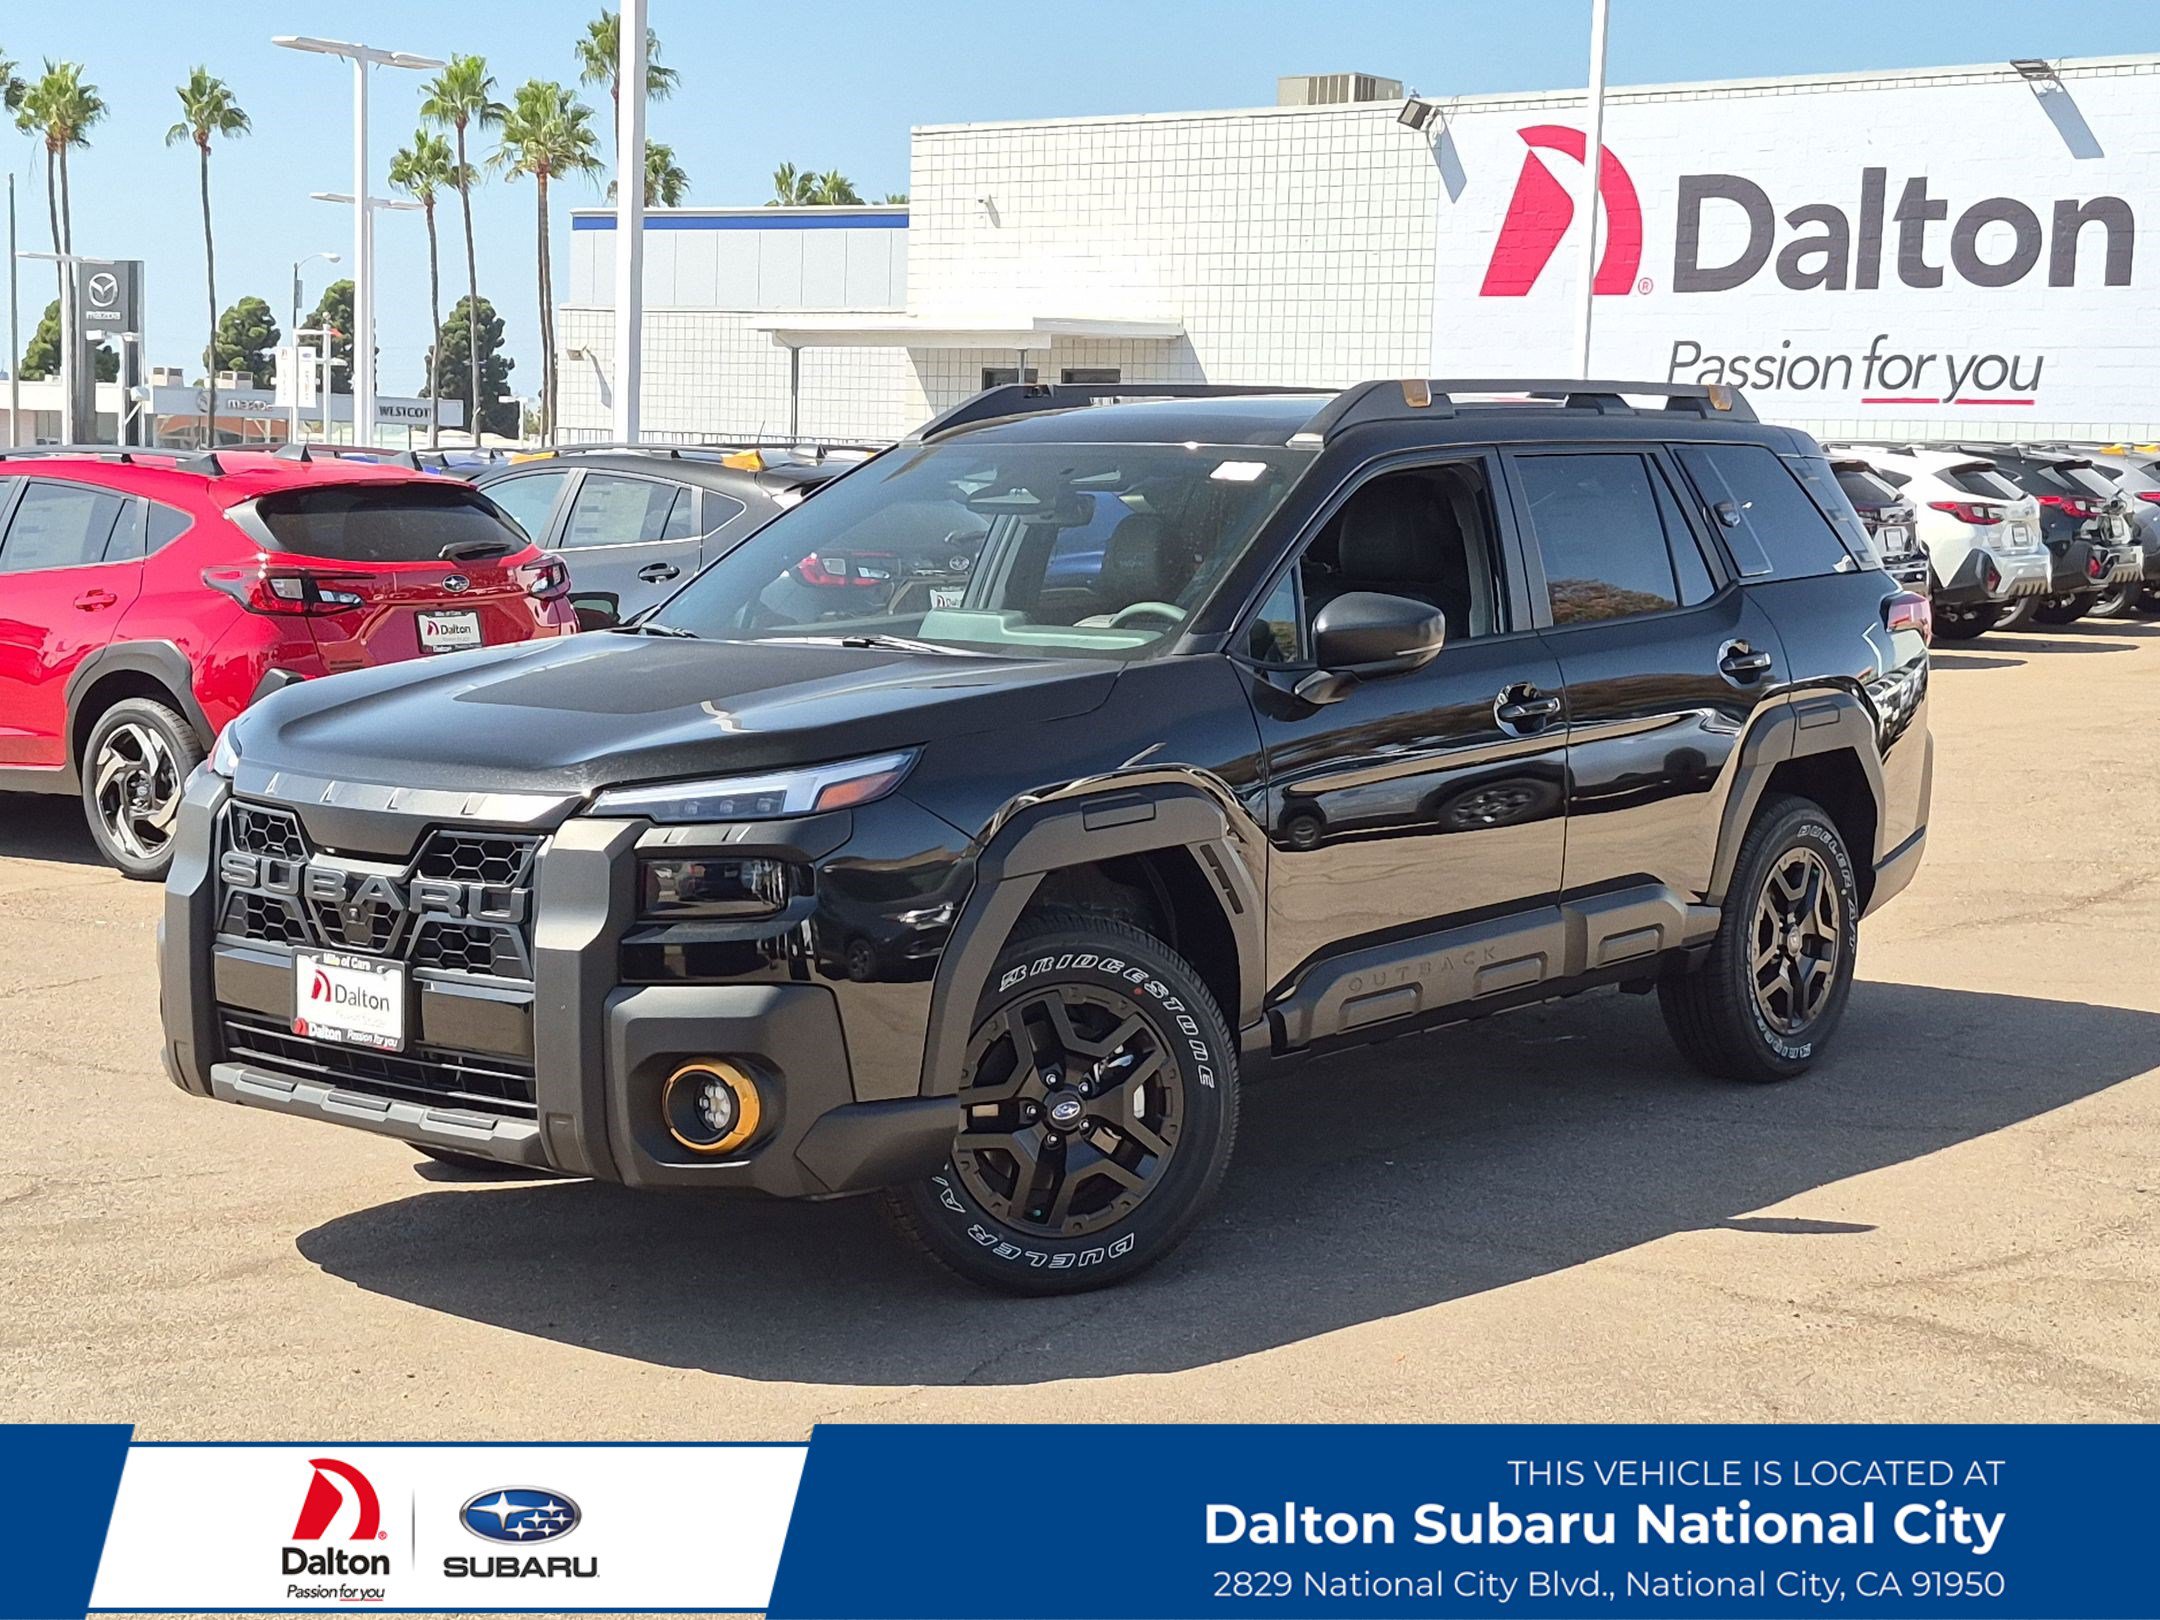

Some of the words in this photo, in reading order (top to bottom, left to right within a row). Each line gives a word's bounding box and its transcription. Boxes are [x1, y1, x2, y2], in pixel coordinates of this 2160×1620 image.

[1673, 167, 2134, 293] Dalton
[1666, 339, 1852, 391] Passion
[1862, 334, 1938, 390] for
[1943, 354, 2044, 403] you
[440, 623, 472, 635] Dalton
[1797, 824, 1853, 890] DUELER
[220, 849, 529, 923] SUBARU
[1348, 945, 1496, 993] OUTBACK
[335, 984, 390, 1013] Dalton
[999, 953, 1215, 1089] BRIDGESTONE
[308, 1022, 342, 1041] Dalton
[931, 1163, 966, 1213] A/
[967, 1223, 1135, 1270] DUELER
